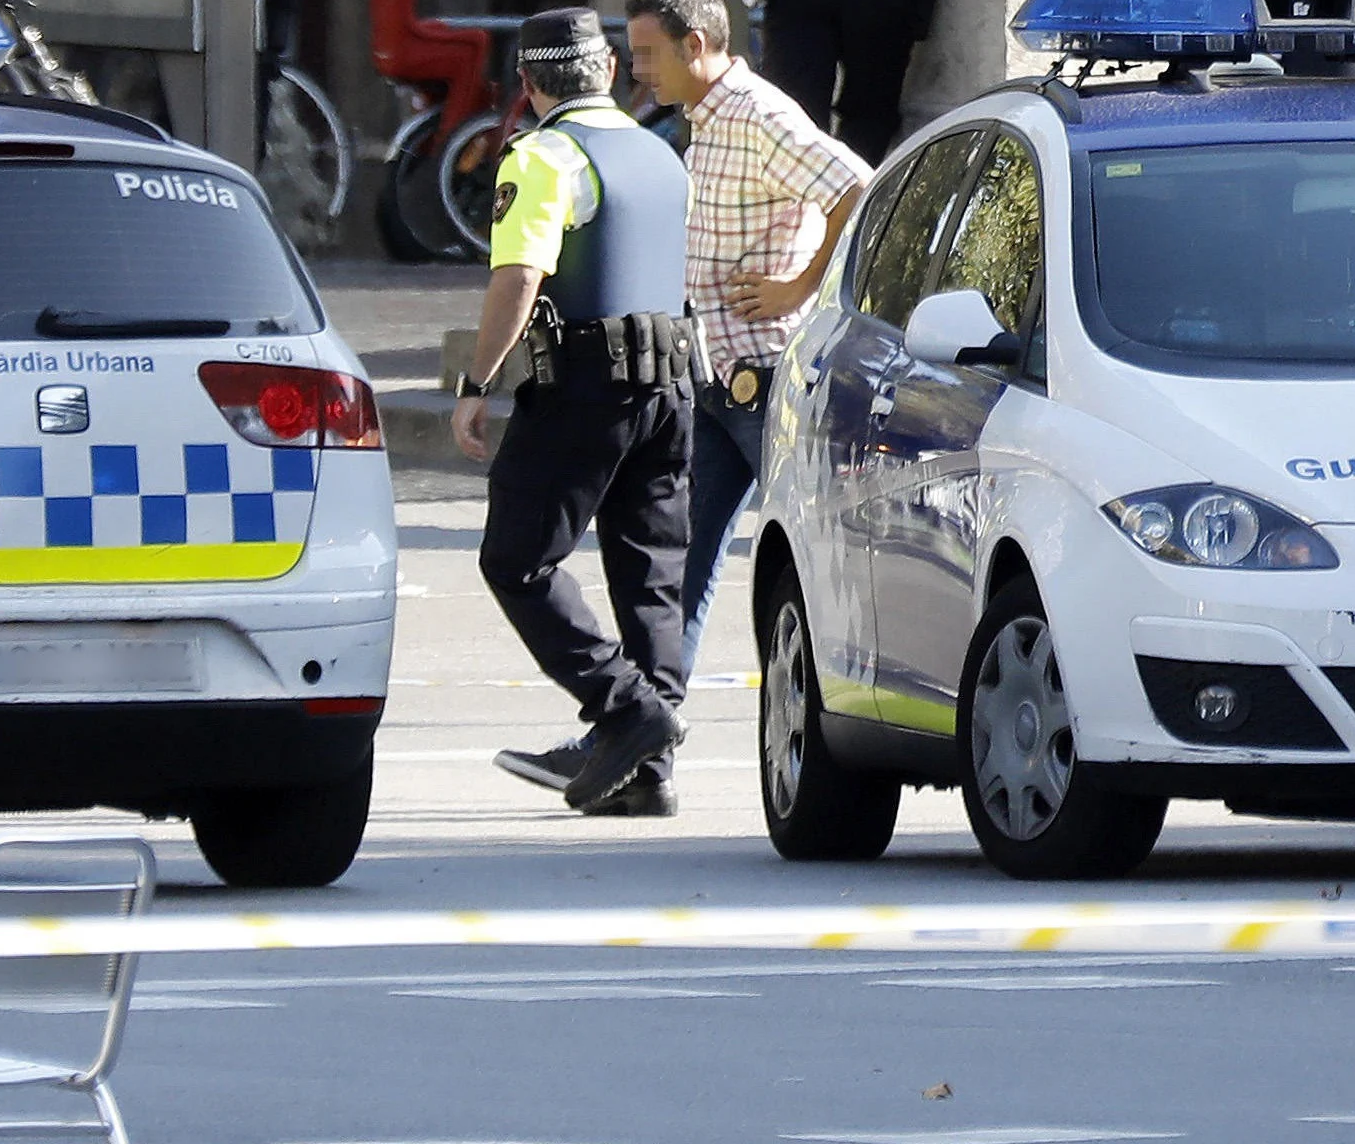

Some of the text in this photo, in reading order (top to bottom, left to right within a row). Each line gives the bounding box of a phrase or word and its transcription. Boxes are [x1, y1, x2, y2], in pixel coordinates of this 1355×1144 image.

[112, 172, 239, 210] Policia
[66, 350, 154, 374] Urbana
[236, 342, 292, 363] C-700
